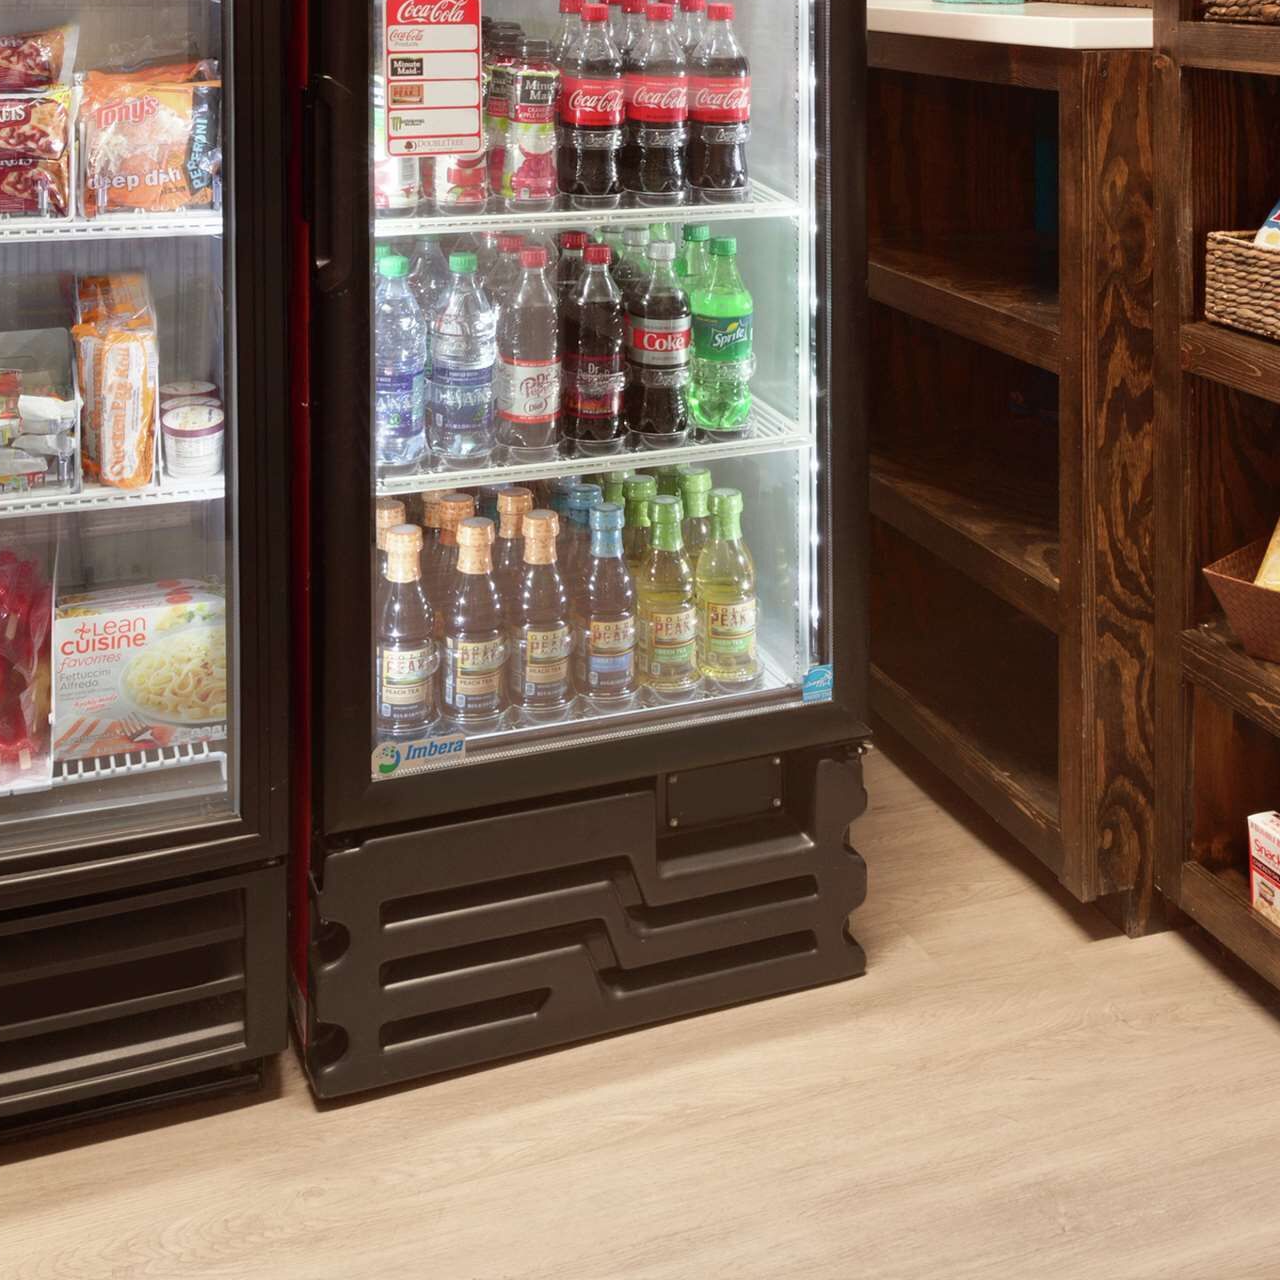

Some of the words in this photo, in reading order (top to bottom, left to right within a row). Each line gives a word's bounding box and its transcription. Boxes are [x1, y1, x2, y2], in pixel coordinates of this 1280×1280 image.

[396, 0, 468, 24] Coca-Cola
[389, 28, 424, 43] Coca-Cola
[393, 61, 421, 69] Minute
[397, 67, 418, 75] Maid
[570, 88, 625, 113] Coca-Cola
[632, 86, 688, 110] Coca-Cola
[695, 87, 750, 110] Coca-Cola
[94, 95, 160, 130] Tony's
[87, 172, 140, 192] deep
[642, 333, 685, 352] Coke
[712, 328, 748, 349] Sprite
[587, 362, 601, 374] Dr
[527, 400, 546, 413] Diet
[93, 616, 147, 637] Lean
[654, 621, 691, 635] PEAK
[58, 652, 121, 674] favorites
[59, 668, 112, 682] Fettuccini
[59, 679, 99, 691] Alfredo
[404, 739, 465, 762] Imbera
